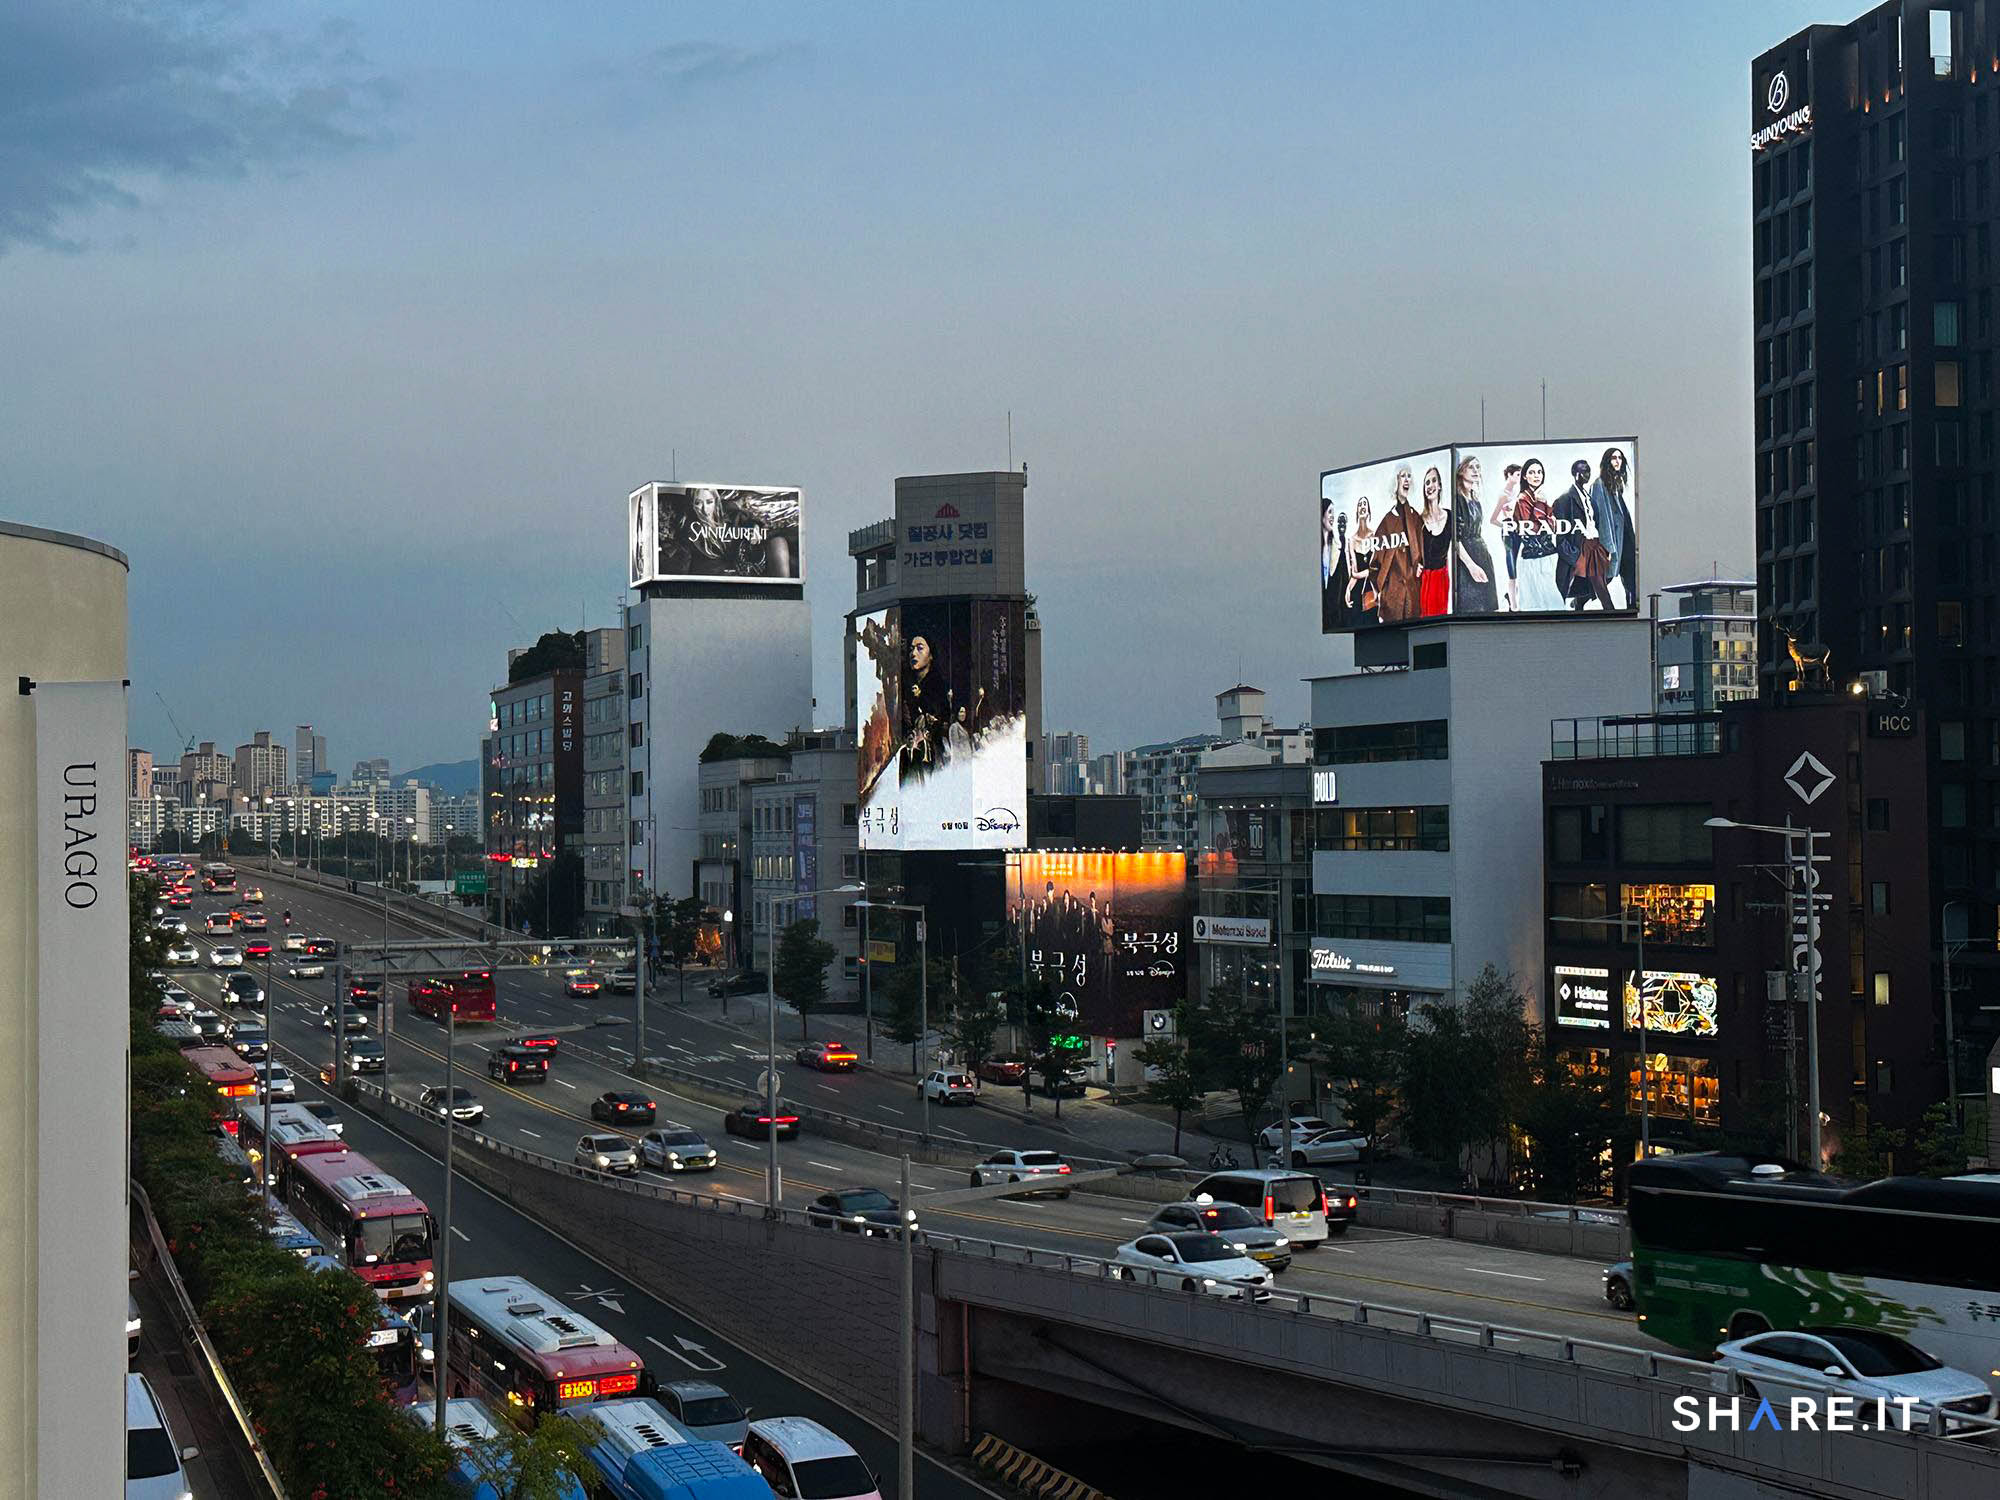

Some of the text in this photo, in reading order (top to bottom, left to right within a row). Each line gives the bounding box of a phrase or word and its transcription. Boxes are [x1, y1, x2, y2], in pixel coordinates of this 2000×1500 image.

[1751, 105, 1811, 150] SHINYOUNG
[1502, 518, 1587, 537] PRADA
[1361, 531, 1409, 555] PRADA
[1879, 715, 1911, 731] HCC
[1314, 772, 1336, 802] BOLD
[975, 808, 1021, 834] Disney+
[64, 762, 97, 909] URAGO
[1791, 832, 1833, 1001] Helino
[1121, 932, 1178, 955] 북극성
[1311, 950, 1351, 969] Titleist
